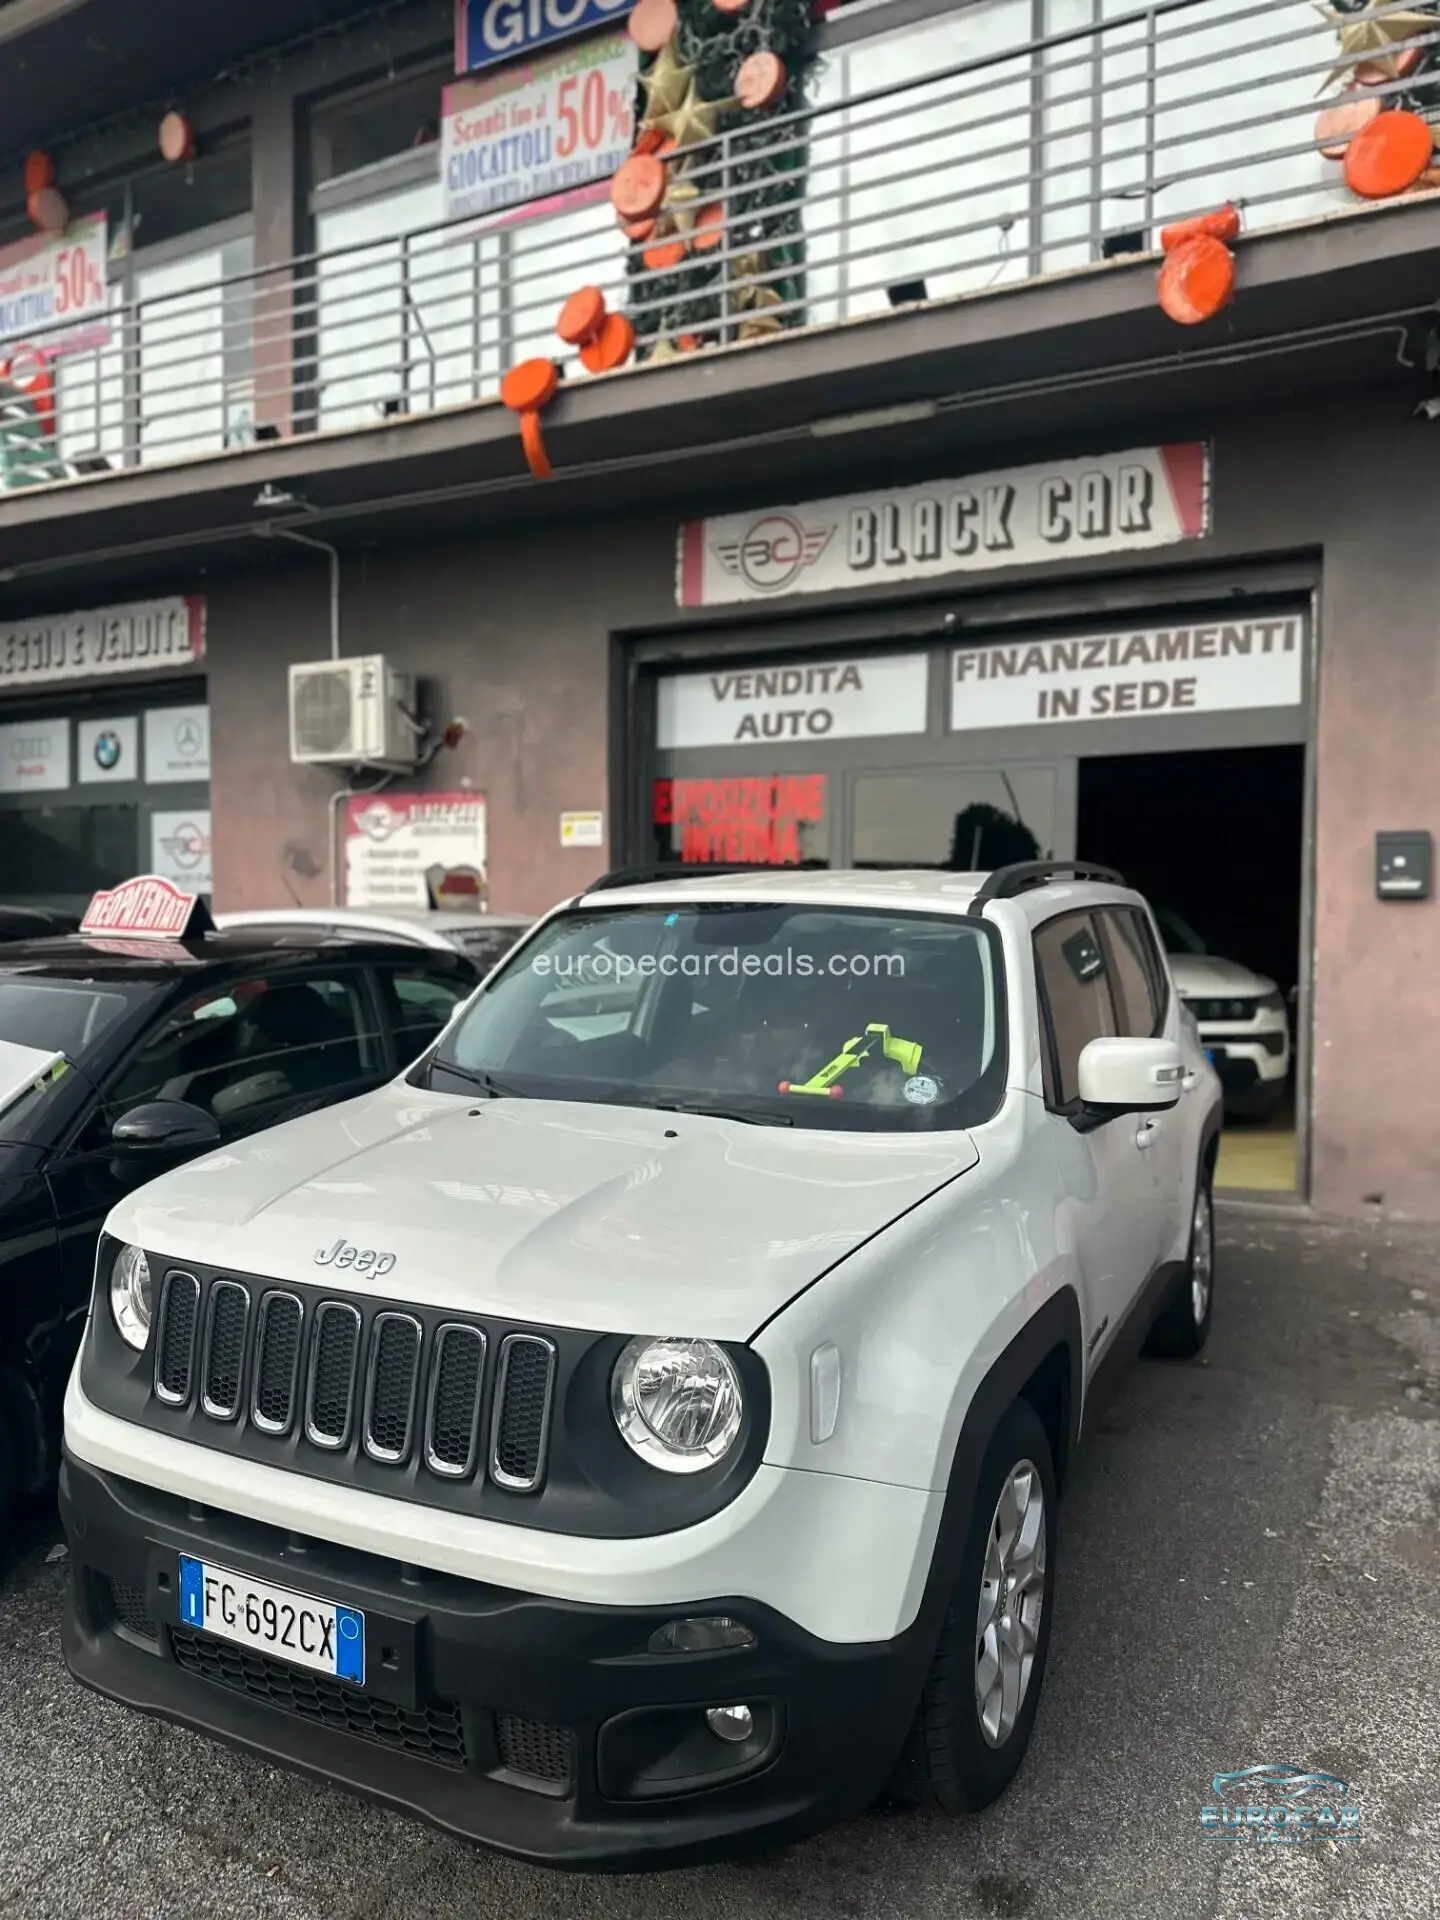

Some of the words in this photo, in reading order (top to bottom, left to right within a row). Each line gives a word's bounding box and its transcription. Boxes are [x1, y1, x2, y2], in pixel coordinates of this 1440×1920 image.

[555, 67, 631, 158] 50%
[447, 123, 552, 191] GIOCATTOLI
[56, 246, 104, 314] 50%
[849, 484, 1016, 571] BLACK
[1038, 465, 1153, 543] CAR
[955, 621, 1297, 682] FINANZIAMENTI
[710, 664, 864, 702] VENDITA
[1037, 688, 1080, 719] IN
[1090, 678, 1198, 715] SEDE
[734, 708, 834, 740] AUTO
[313, 1238, 397, 1280] Jeep
